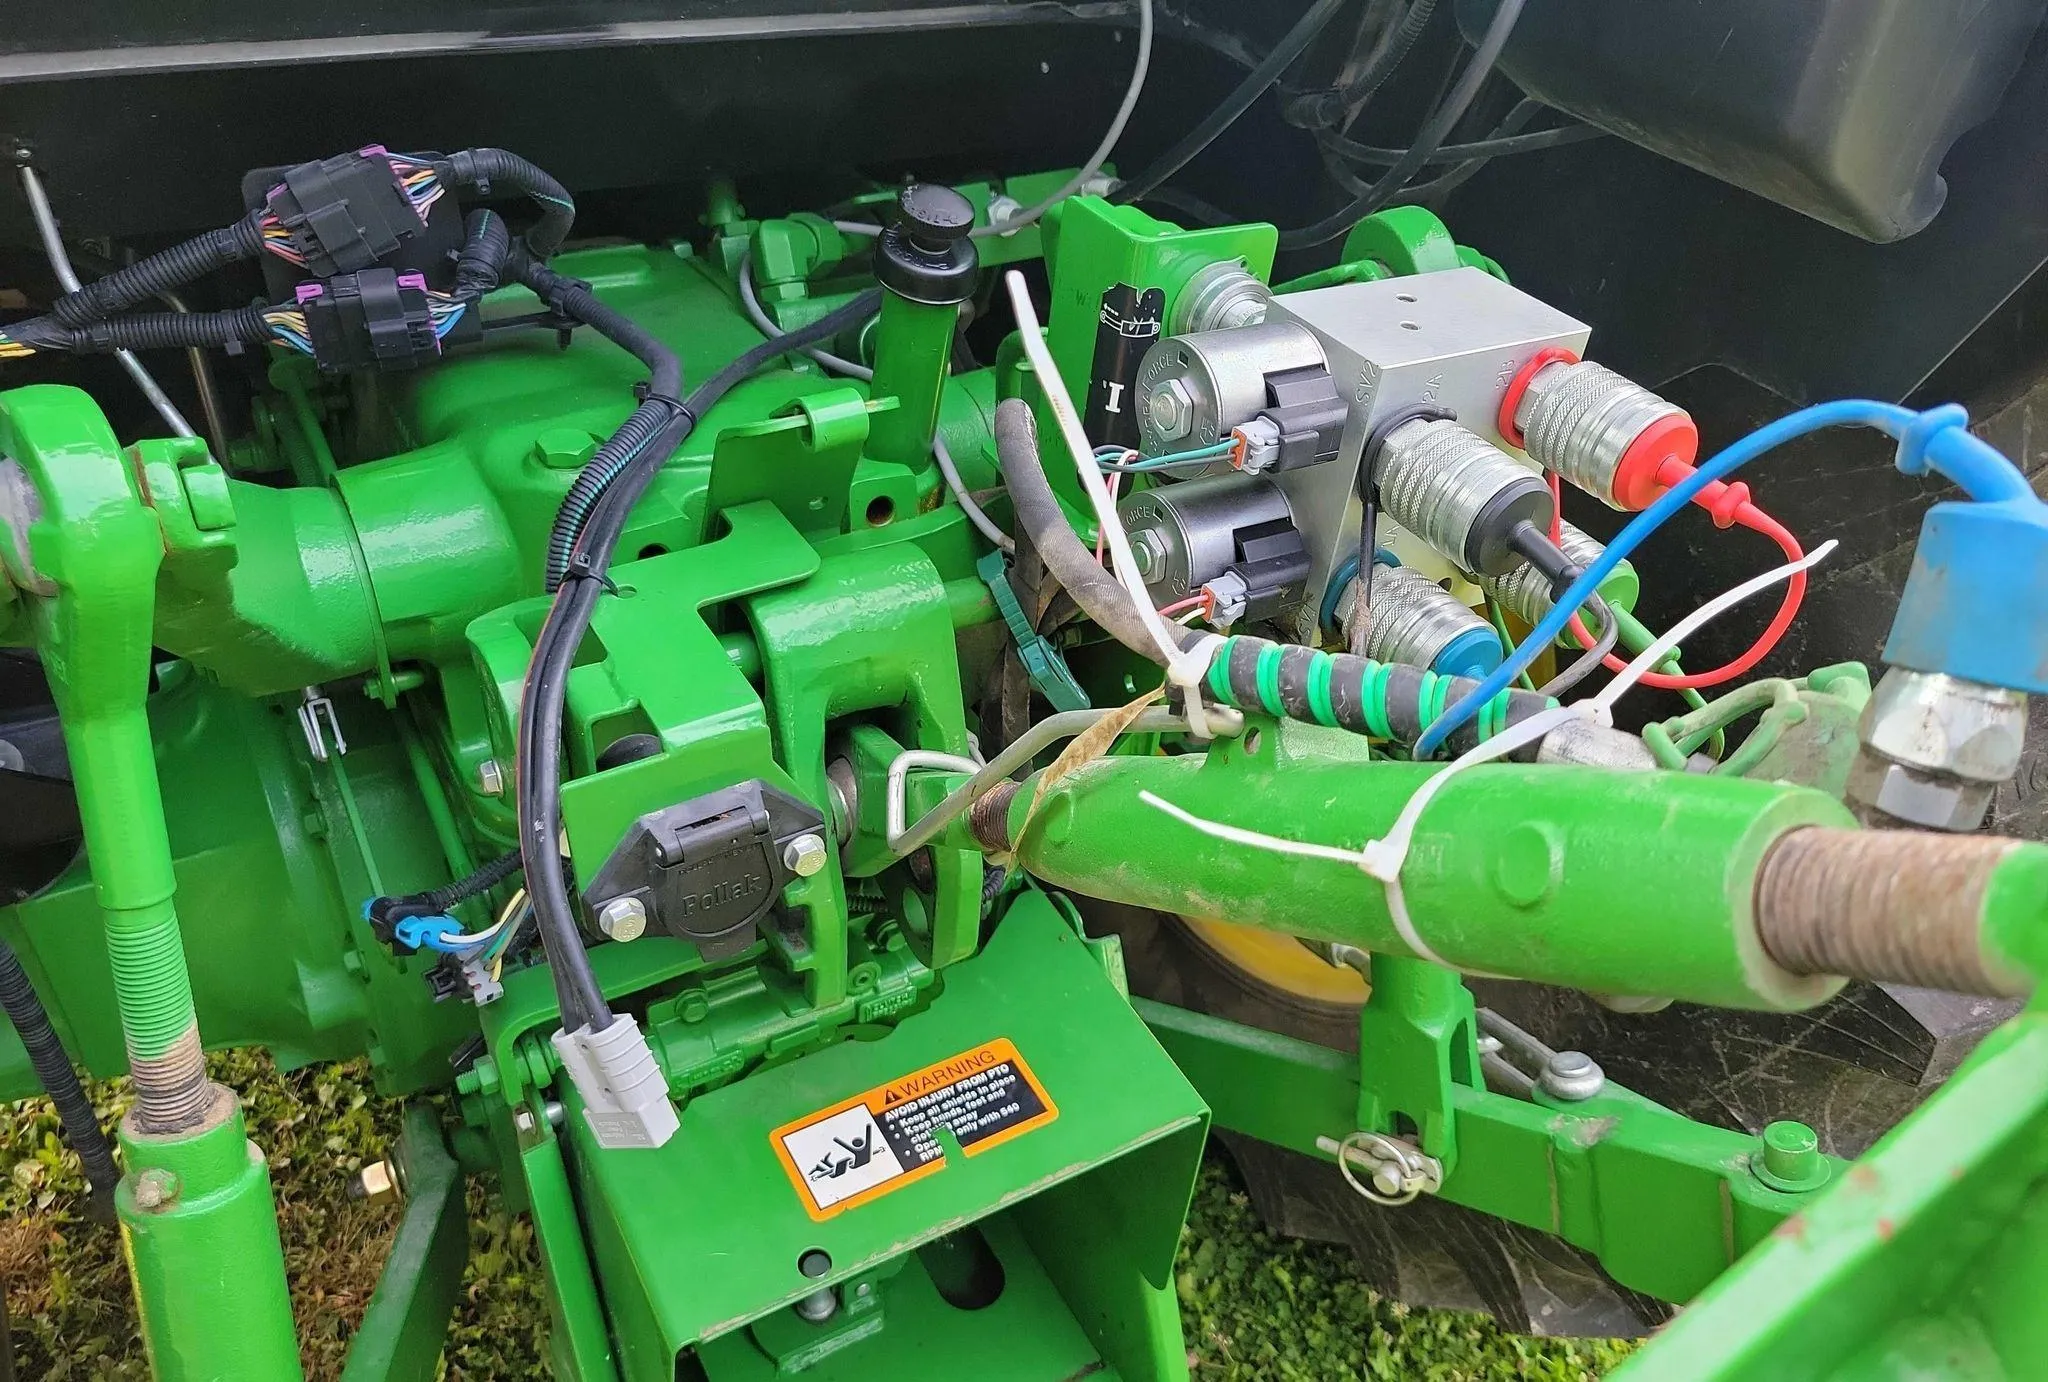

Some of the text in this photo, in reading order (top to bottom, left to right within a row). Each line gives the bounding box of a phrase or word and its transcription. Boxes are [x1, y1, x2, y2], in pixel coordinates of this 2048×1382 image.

[1354, 359, 1380, 407] SV2
[1421, 368, 1448, 404] 2A
[681, 872, 763, 918] Pollak
[884, 1063, 1010, 1122] AVOID INJURY FROM PTO
[899, 1050, 996, 1097] WARNING
[898, 1074, 1016, 1128] Keep all shields in place
[903, 1088, 1006, 1138] Keep hands, feet and
[952, 1110, 978, 1129] away
[956, 1121, 978, 1136] only
[978, 1113, 1001, 1127] with
[1000, 1101, 1020, 1117] 540
[918, 1144, 944, 1163] RPM
